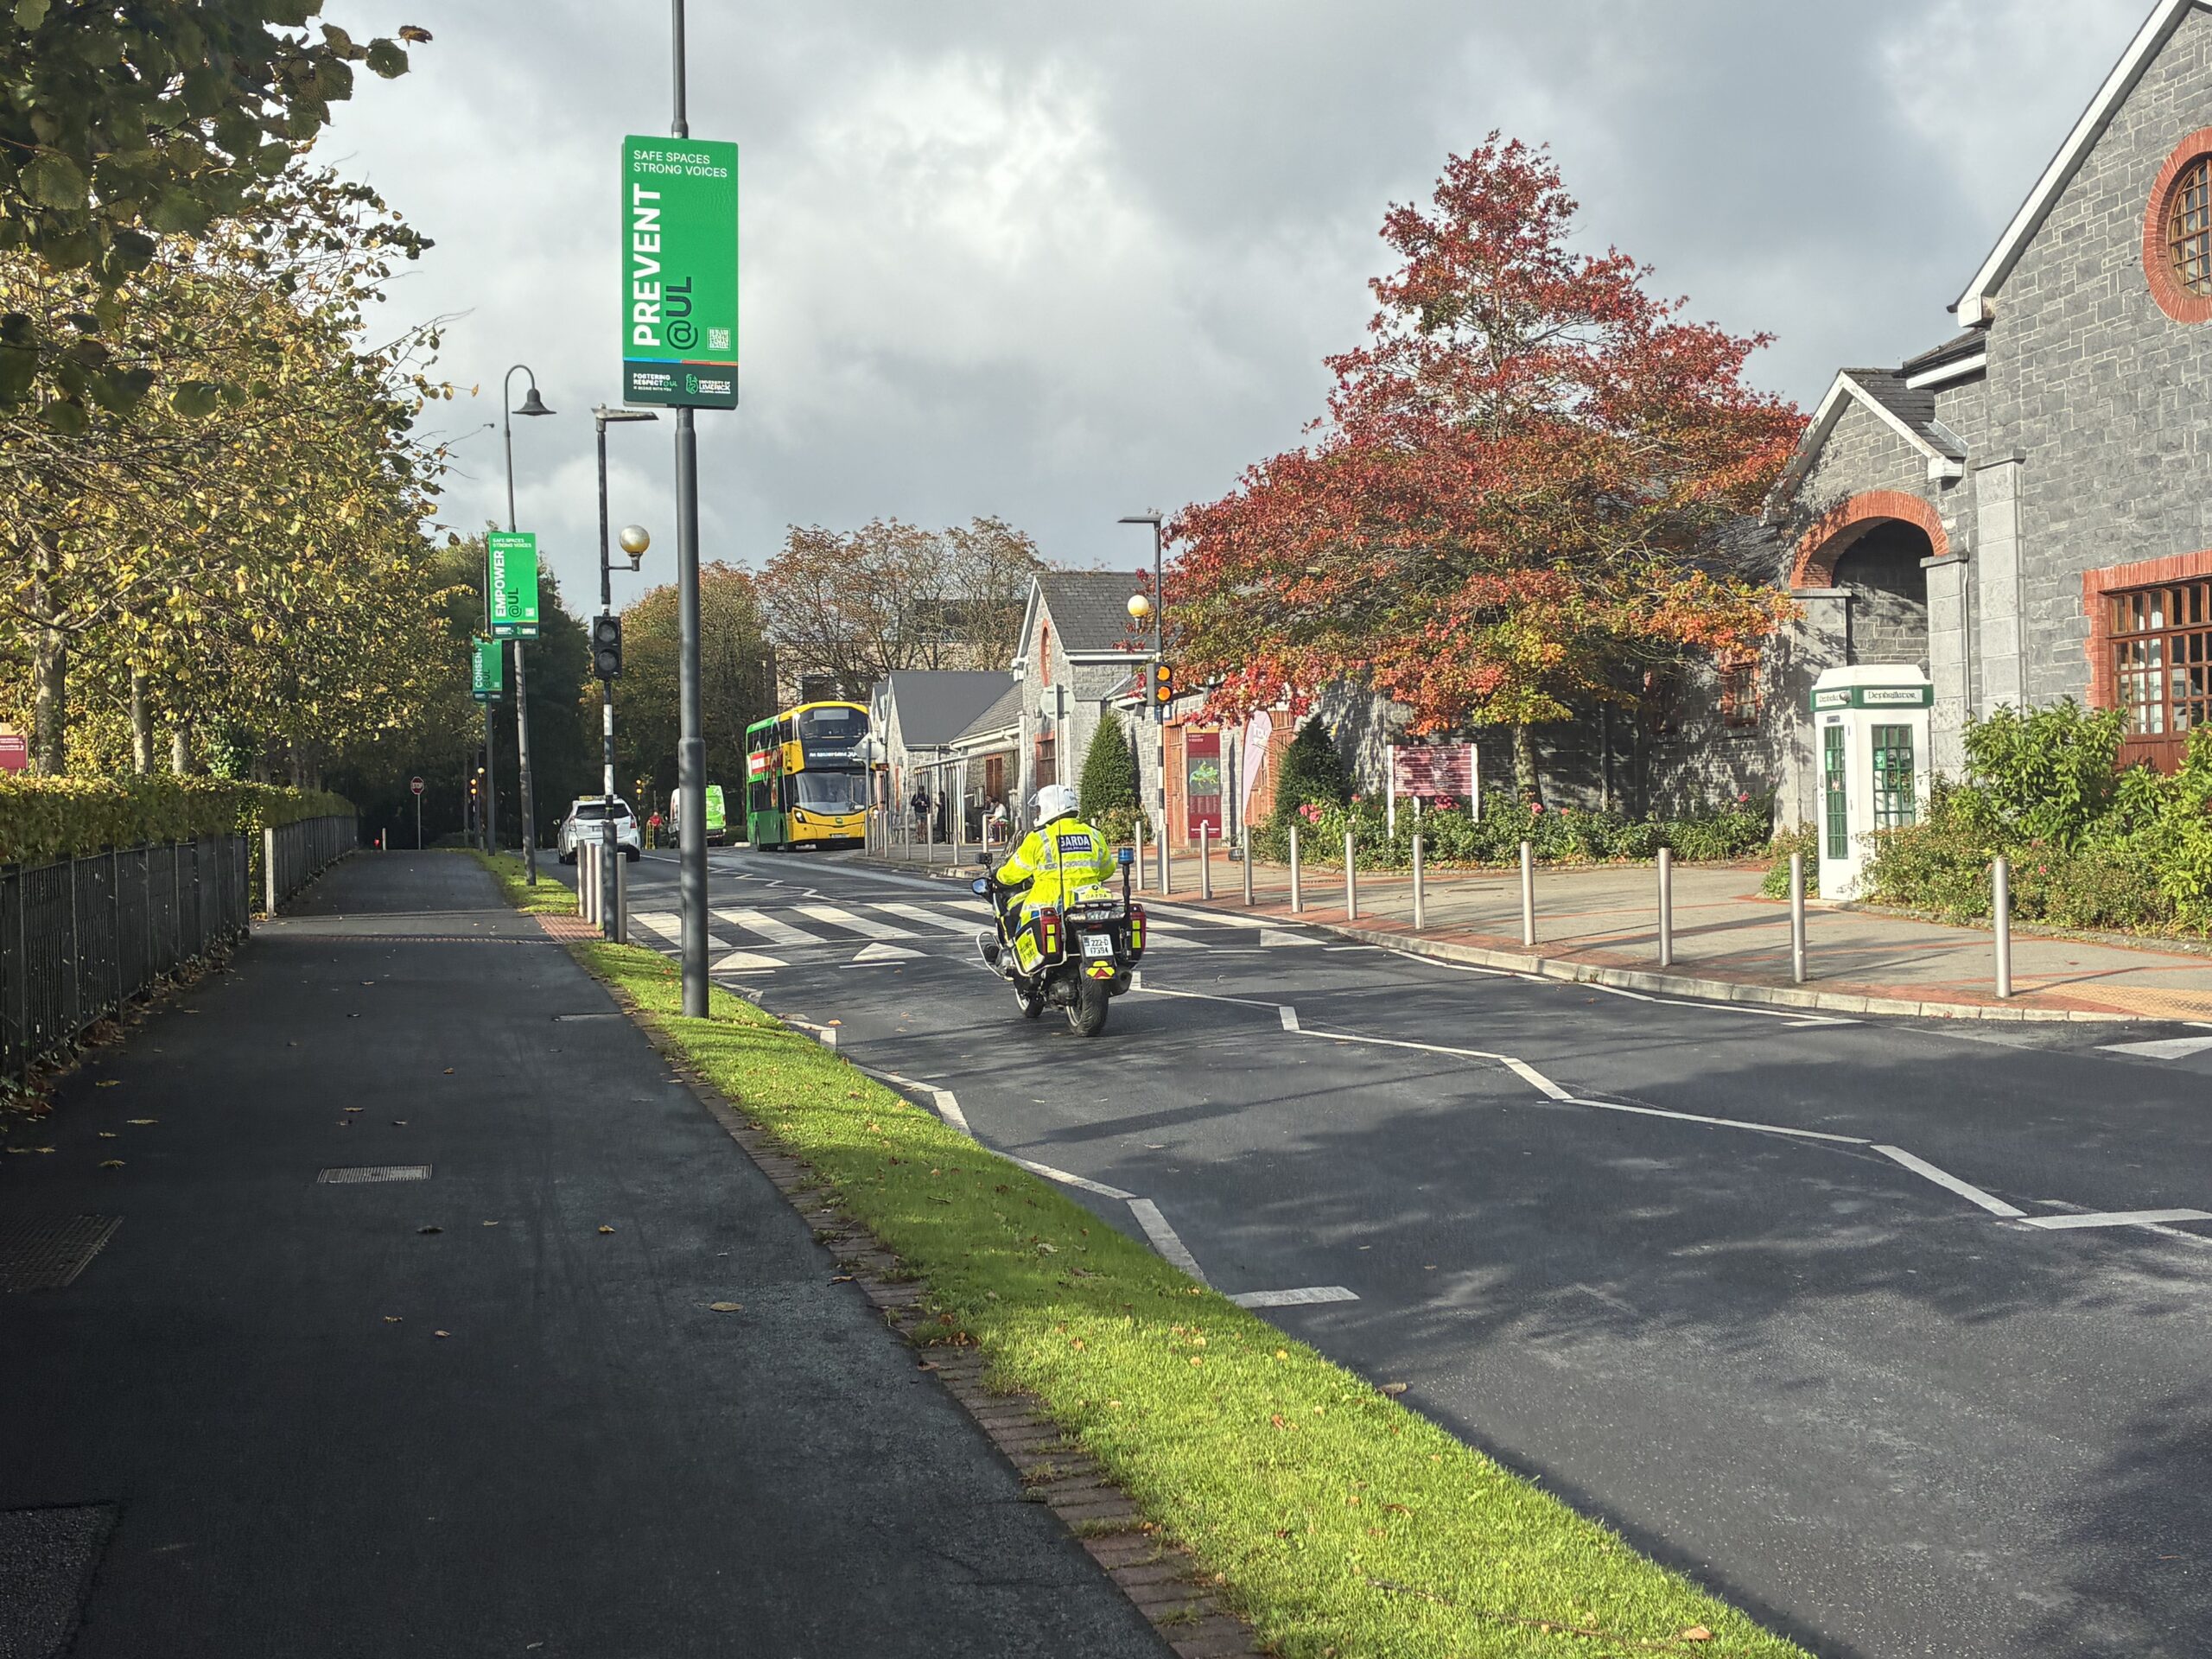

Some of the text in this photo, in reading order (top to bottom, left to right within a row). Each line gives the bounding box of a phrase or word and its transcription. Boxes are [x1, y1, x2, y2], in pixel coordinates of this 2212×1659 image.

[632, 149, 710, 165] SAFE SPACES
[632, 162, 728, 178] STRONG VOICES
[632, 183, 661, 346] PREVENT
[665, 276, 698, 351] @UL
[493, 550, 506, 618] EMPOWER
[507, 588, 522, 618] @UL
[474, 648, 483, 689] CONSEN
[1058, 836, 1090, 847] GARDA
